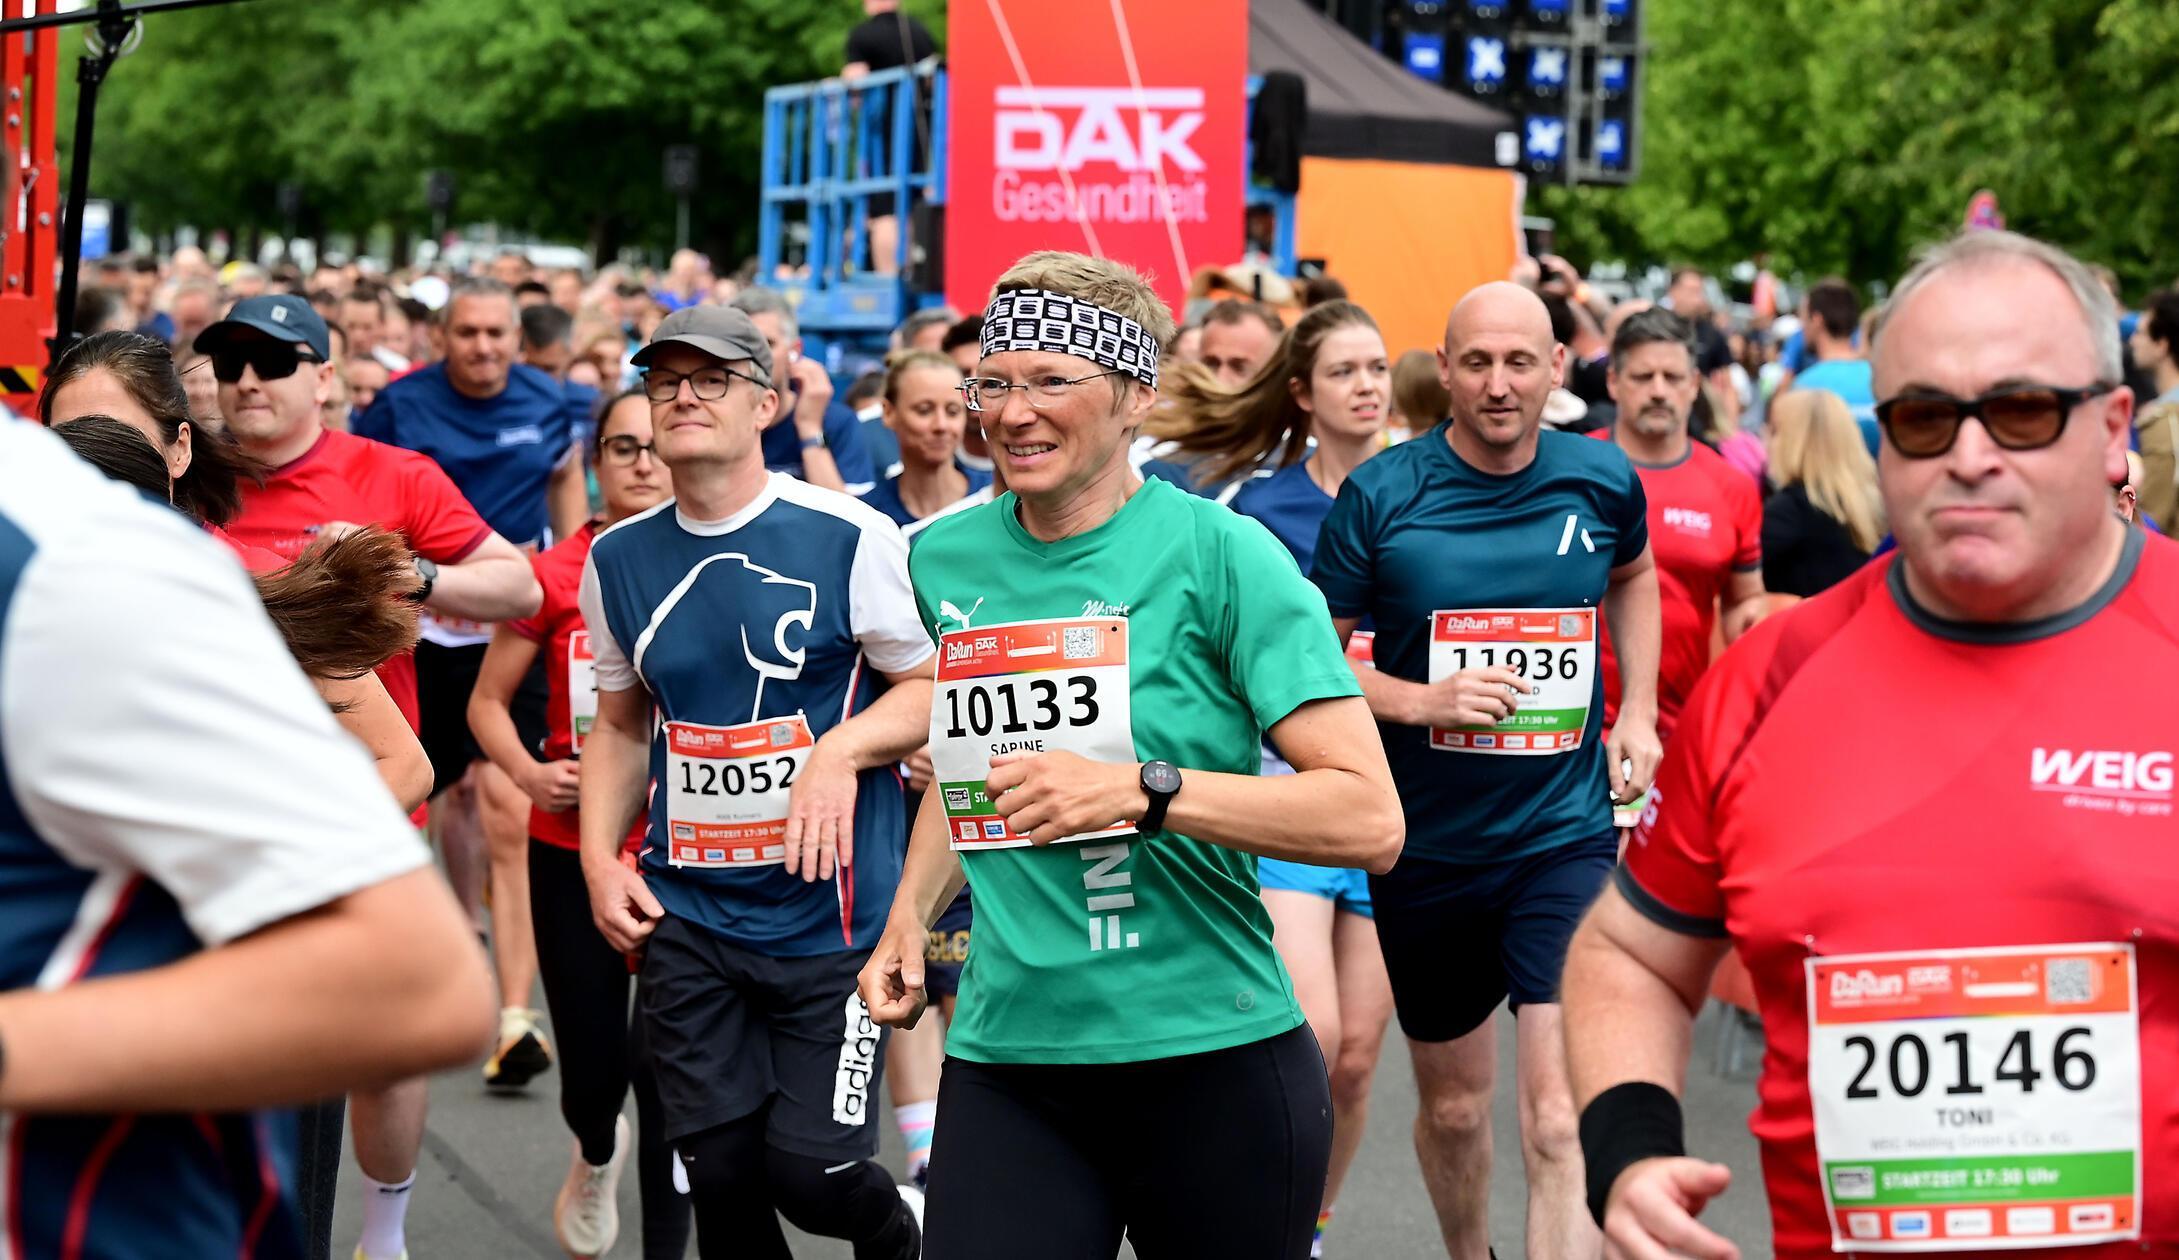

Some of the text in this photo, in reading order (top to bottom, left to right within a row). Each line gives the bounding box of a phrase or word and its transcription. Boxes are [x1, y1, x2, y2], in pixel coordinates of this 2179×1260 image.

[995, 87, 1206, 171] DAK
[993, 170, 1207, 222] Gesundheit
[947, 636, 998, 661] DaRun DAK
[1453, 648, 1578, 681] 11936
[946, 676, 1100, 738] 10133
[991, 739, 1044, 755] SABINE
[681, 756, 796, 795] 12052
[2030, 747, 2174, 791] WEIG
[845, 1000, 875, 1116] adida
[1845, 1027, 2096, 1099] 20146
[1936, 1108, 1993, 1127] TONI
[1882, 1169, 1968, 1190] STARTZEIT
[1973, 1167, 2023, 1187] 17:30
[2026, 1166, 2061, 1185] Uhr
